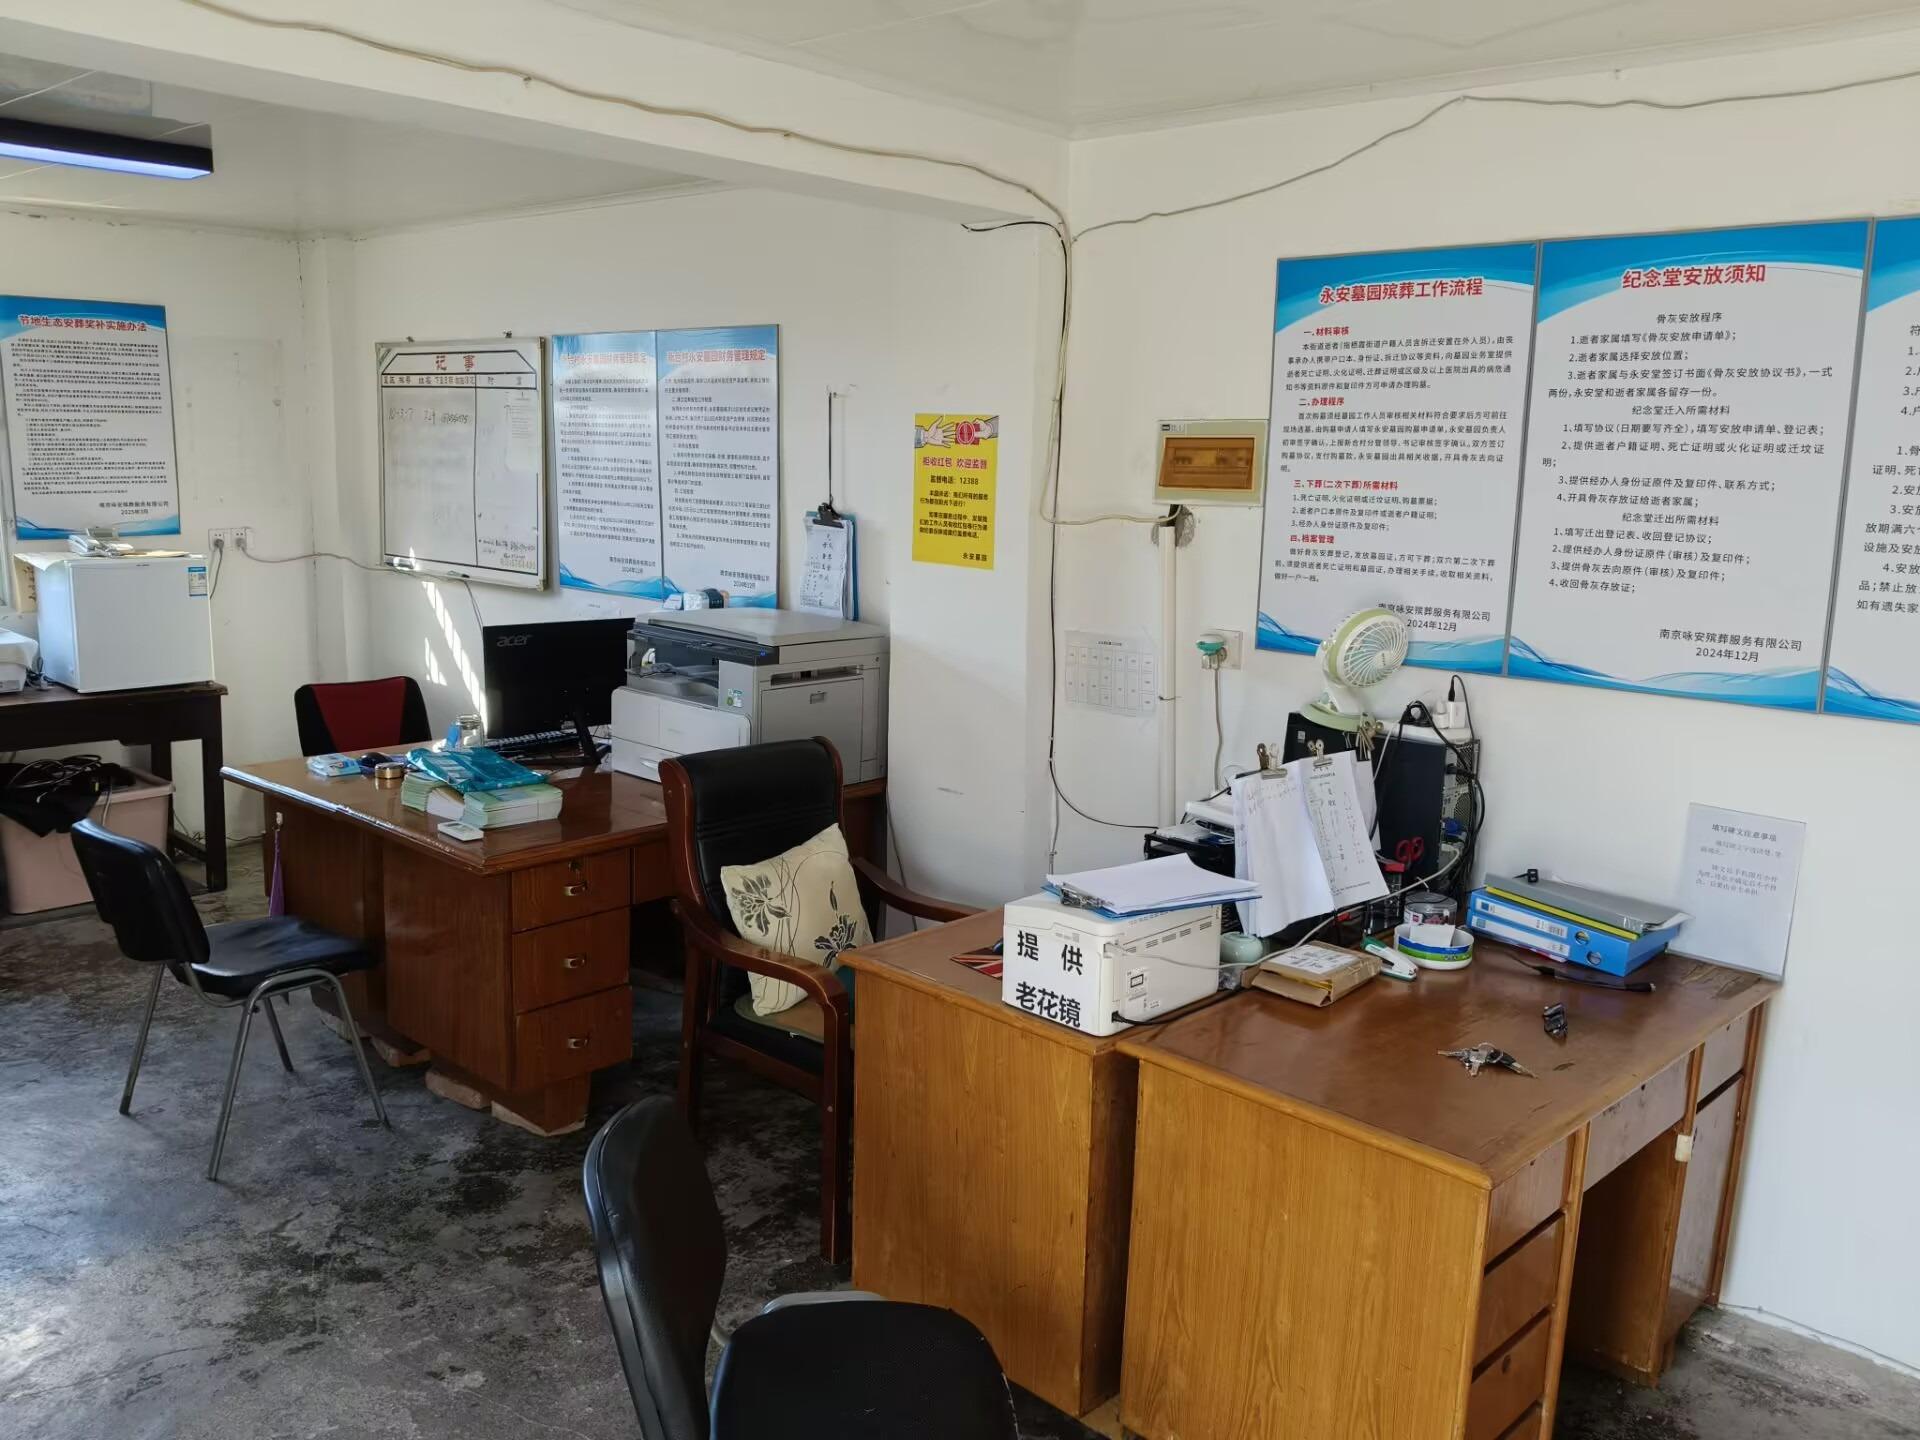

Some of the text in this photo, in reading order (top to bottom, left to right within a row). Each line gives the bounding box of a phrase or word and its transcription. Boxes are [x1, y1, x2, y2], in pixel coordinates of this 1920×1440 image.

[1622, 264, 1766, 289] 纪念堂安放须知
[1319, 278, 1484, 304] 永安墓园殡葬工作流程
[1656, 312, 1723, 325] 骨灰安放程序
[1908, 346, 1920, 355] 1.
[1632, 405, 1730, 417] 纪念堂迁入所需材料
[923, 456, 987, 469] 拒收红包 欢迎监督
[1872, 465, 1920, 476] 证明、死
[1622, 513, 1719, 526] 纪念堂迁出所需材料
[1865, 523, 1920, 534] 放期满六
[1407, 619, 1457, 632] 2024年12月
[496, 634, 533, 647] acer
[1659, 628, 1802, 652] 南京咏安殡葬服务有限公司
[1695, 647, 1759, 663] 2024年12月
[1015, 981, 1081, 1028] 老花镜
